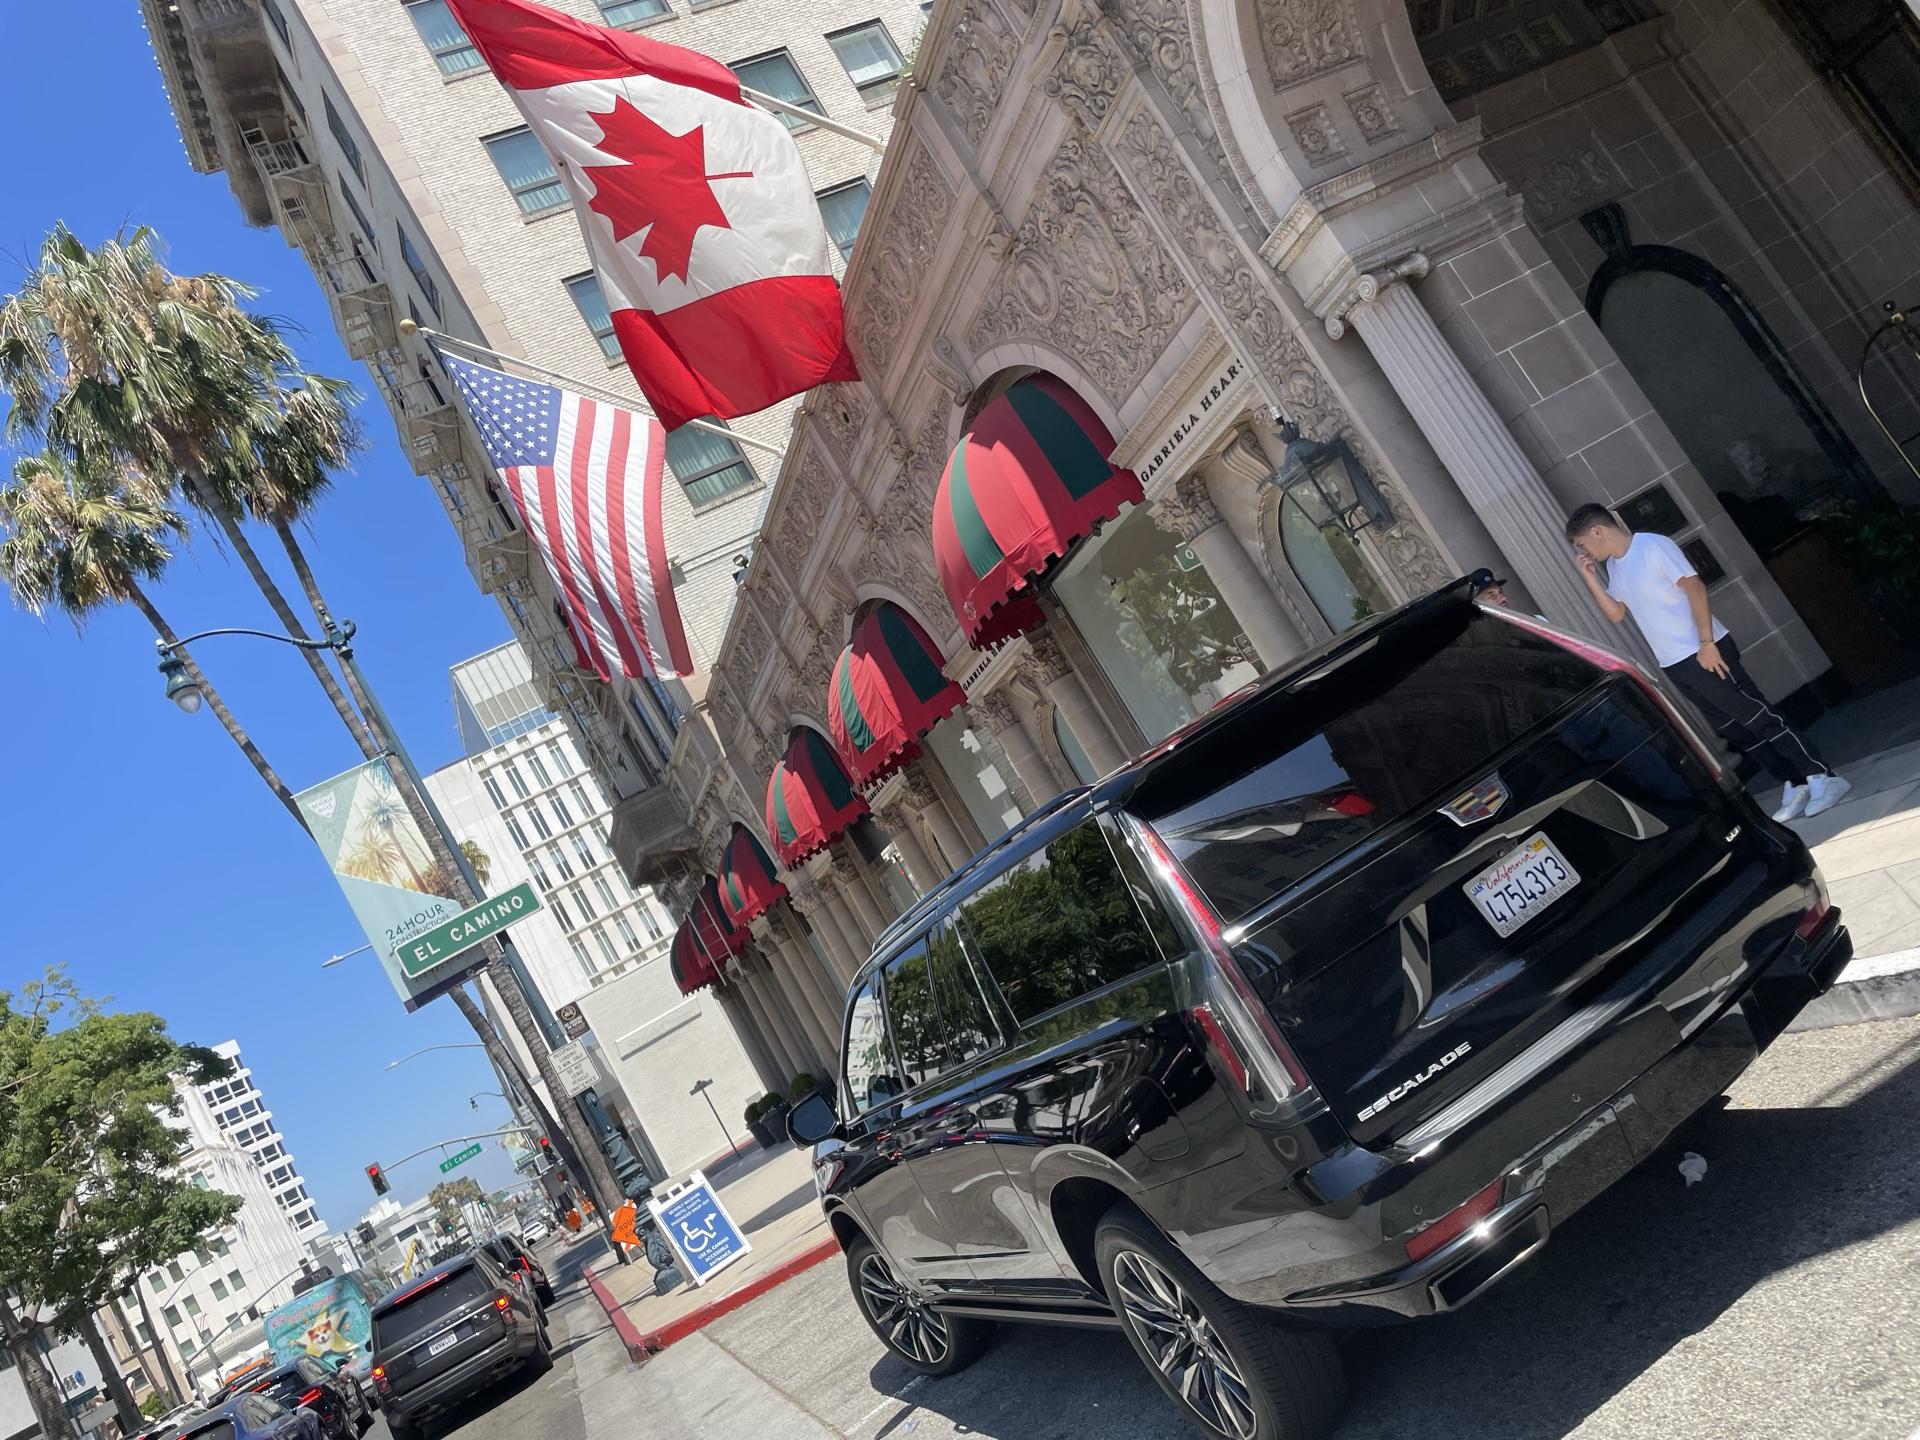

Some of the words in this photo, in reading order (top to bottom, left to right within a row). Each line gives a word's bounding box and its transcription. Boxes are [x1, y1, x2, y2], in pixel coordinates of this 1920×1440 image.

[1140, 413, 1200, 483] GABRIELA
[1200, 358, 1244, 412] HEAR
[1471, 882, 1485, 896] JAN
[1484, 852, 1537, 890] California
[1485, 856, 1567, 923] 47543Y3
[1500, 908, 1534, 935] CADILLAC
[1532, 889, 1560, 914] BEVERLY
[1558, 875, 1578, 892] HILLS
[385, 903, 445, 940] 24-HOUR
[390, 914, 450, 948] CONSTRUCTION
[413, 941, 441, 962] EL
[450, 895, 524, 942] CAMINO
[1357, 1041, 1472, 1122] ESCALADE
